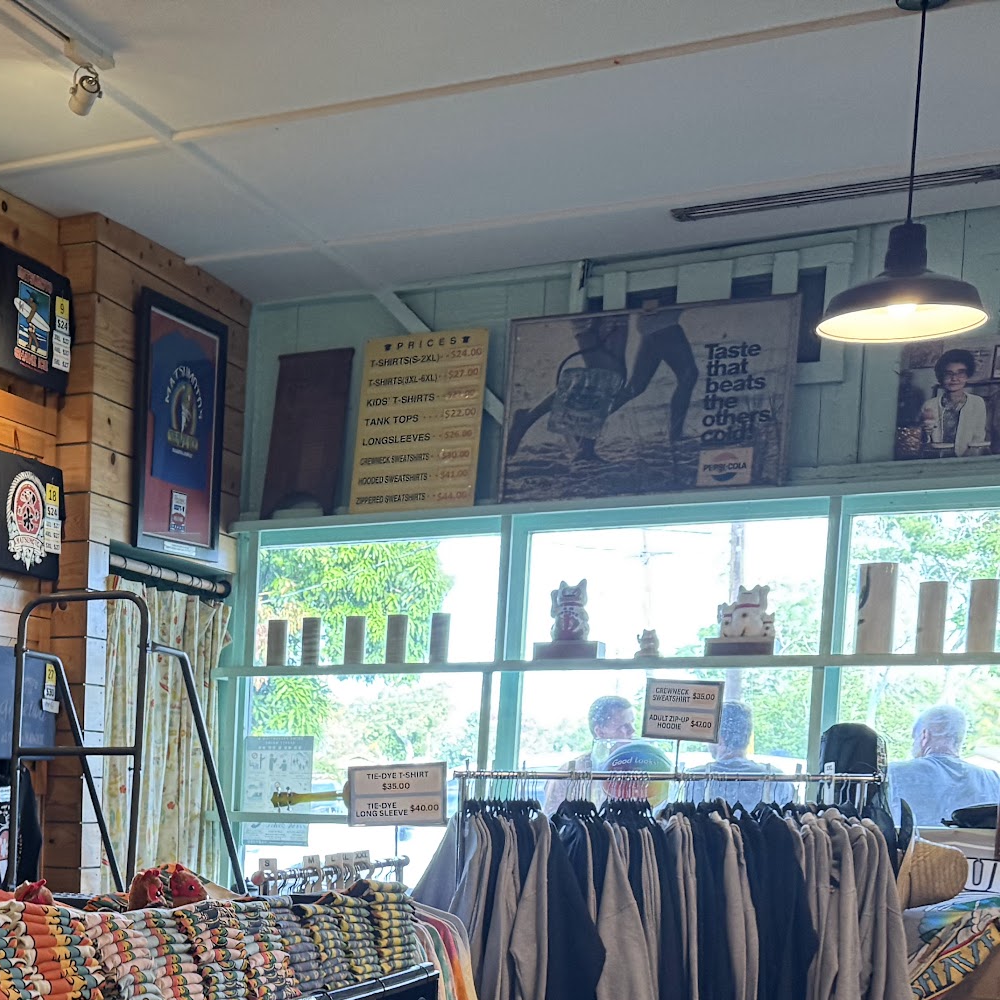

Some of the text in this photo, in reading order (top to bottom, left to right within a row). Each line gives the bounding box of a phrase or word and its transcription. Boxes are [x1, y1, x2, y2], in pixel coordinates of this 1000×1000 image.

[60, 303, 64, 314] 9
[58, 320, 68, 330] $24
[397, 336, 457, 349] PRICES
[705, 342, 761, 360] Taste
[707, 358, 748, 376] that
[706, 375, 766, 393] beats
[703, 394, 738, 410] the
[365, 408, 476, 426] TANK TOPS $22.00
[702, 409, 770, 426] others
[362, 433, 430, 446] LONGSLEEVES
[704, 462, 746, 472] PEPSI-COLA
[358, 476, 383, 485] HOODED
[49, 489, 57, 502] 18
[47, 507, 58, 516] $24
[652, 695, 690, 703] SWEATSHIRT
[691, 720, 712, 728] $47.00
[399, 771, 429, 779] T-SHIRT
[382, 782, 410, 790] $35.00
[410, 803, 439, 812] $40.00
[308, 856, 314, 864] M
